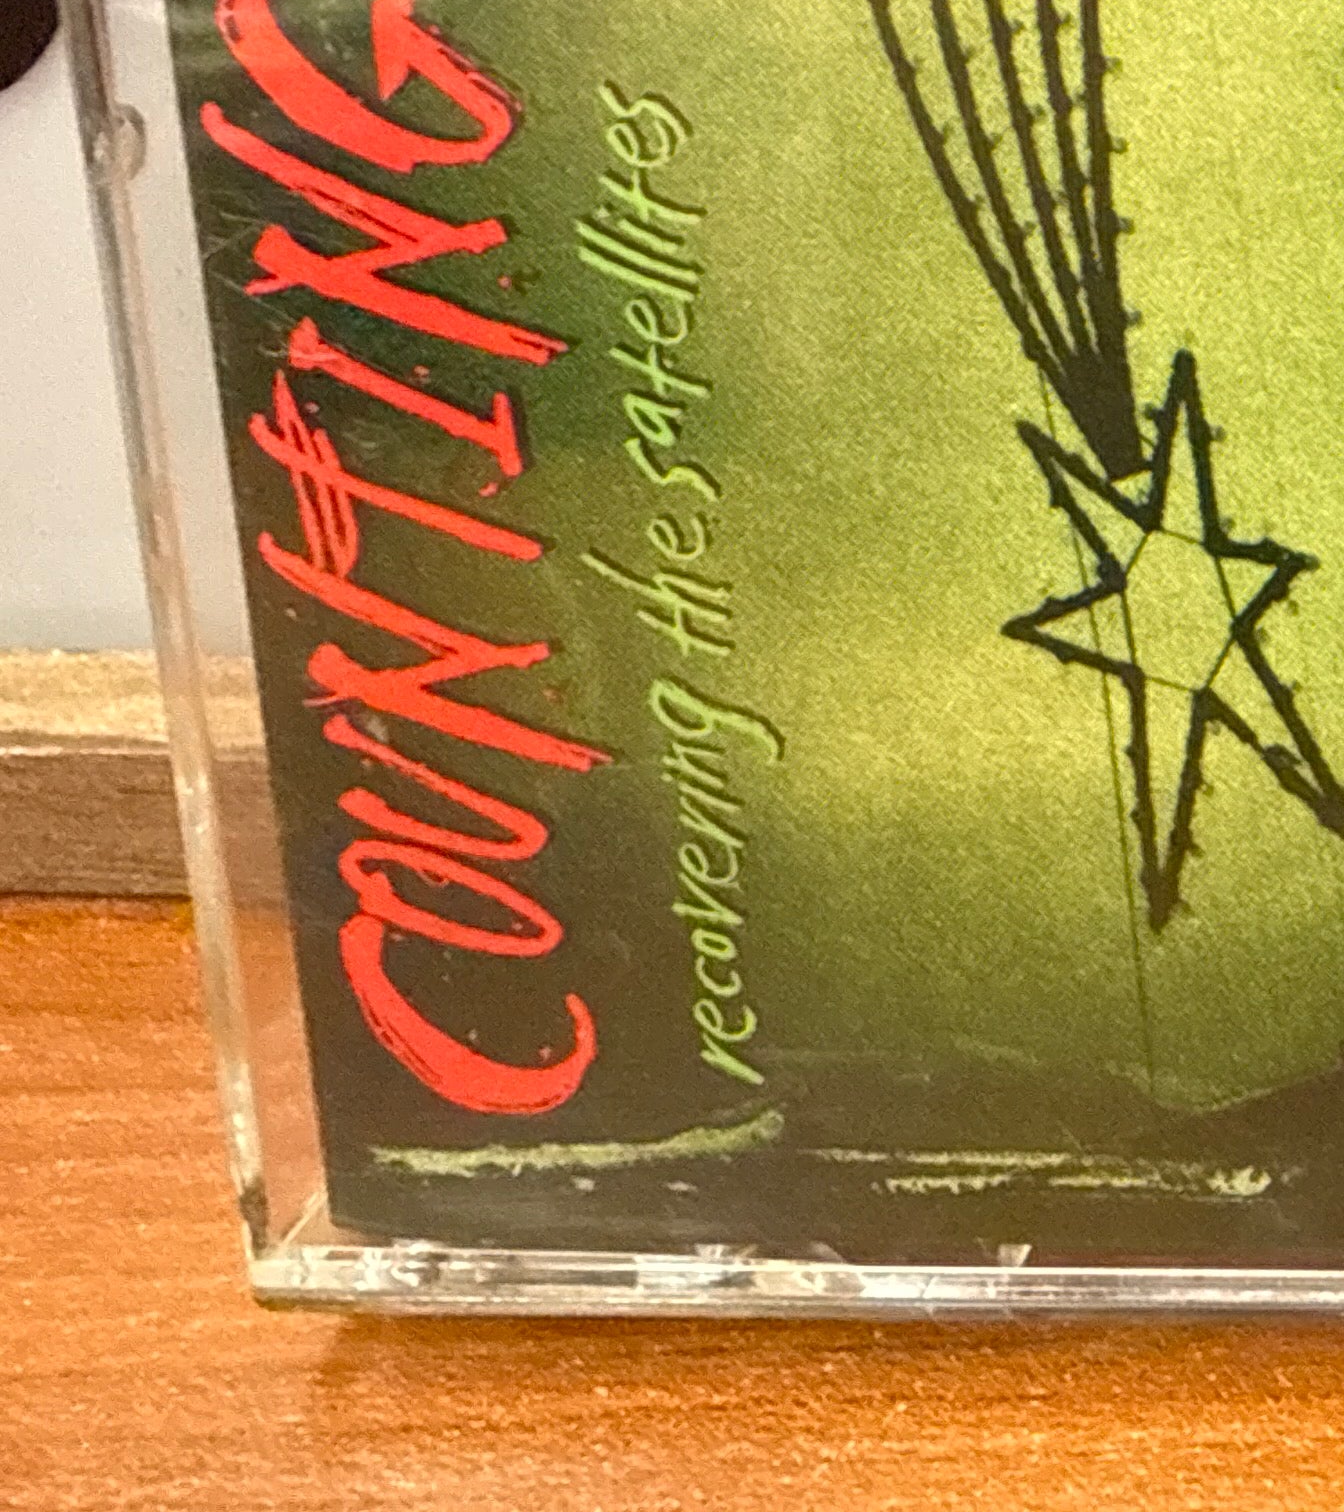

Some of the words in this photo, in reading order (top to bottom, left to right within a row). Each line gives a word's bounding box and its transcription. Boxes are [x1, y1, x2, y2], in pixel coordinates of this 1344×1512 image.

[575, 82, 713, 503] satellites
[580, 513, 734, 657] the
[648, 676, 785, 1086] recovering
